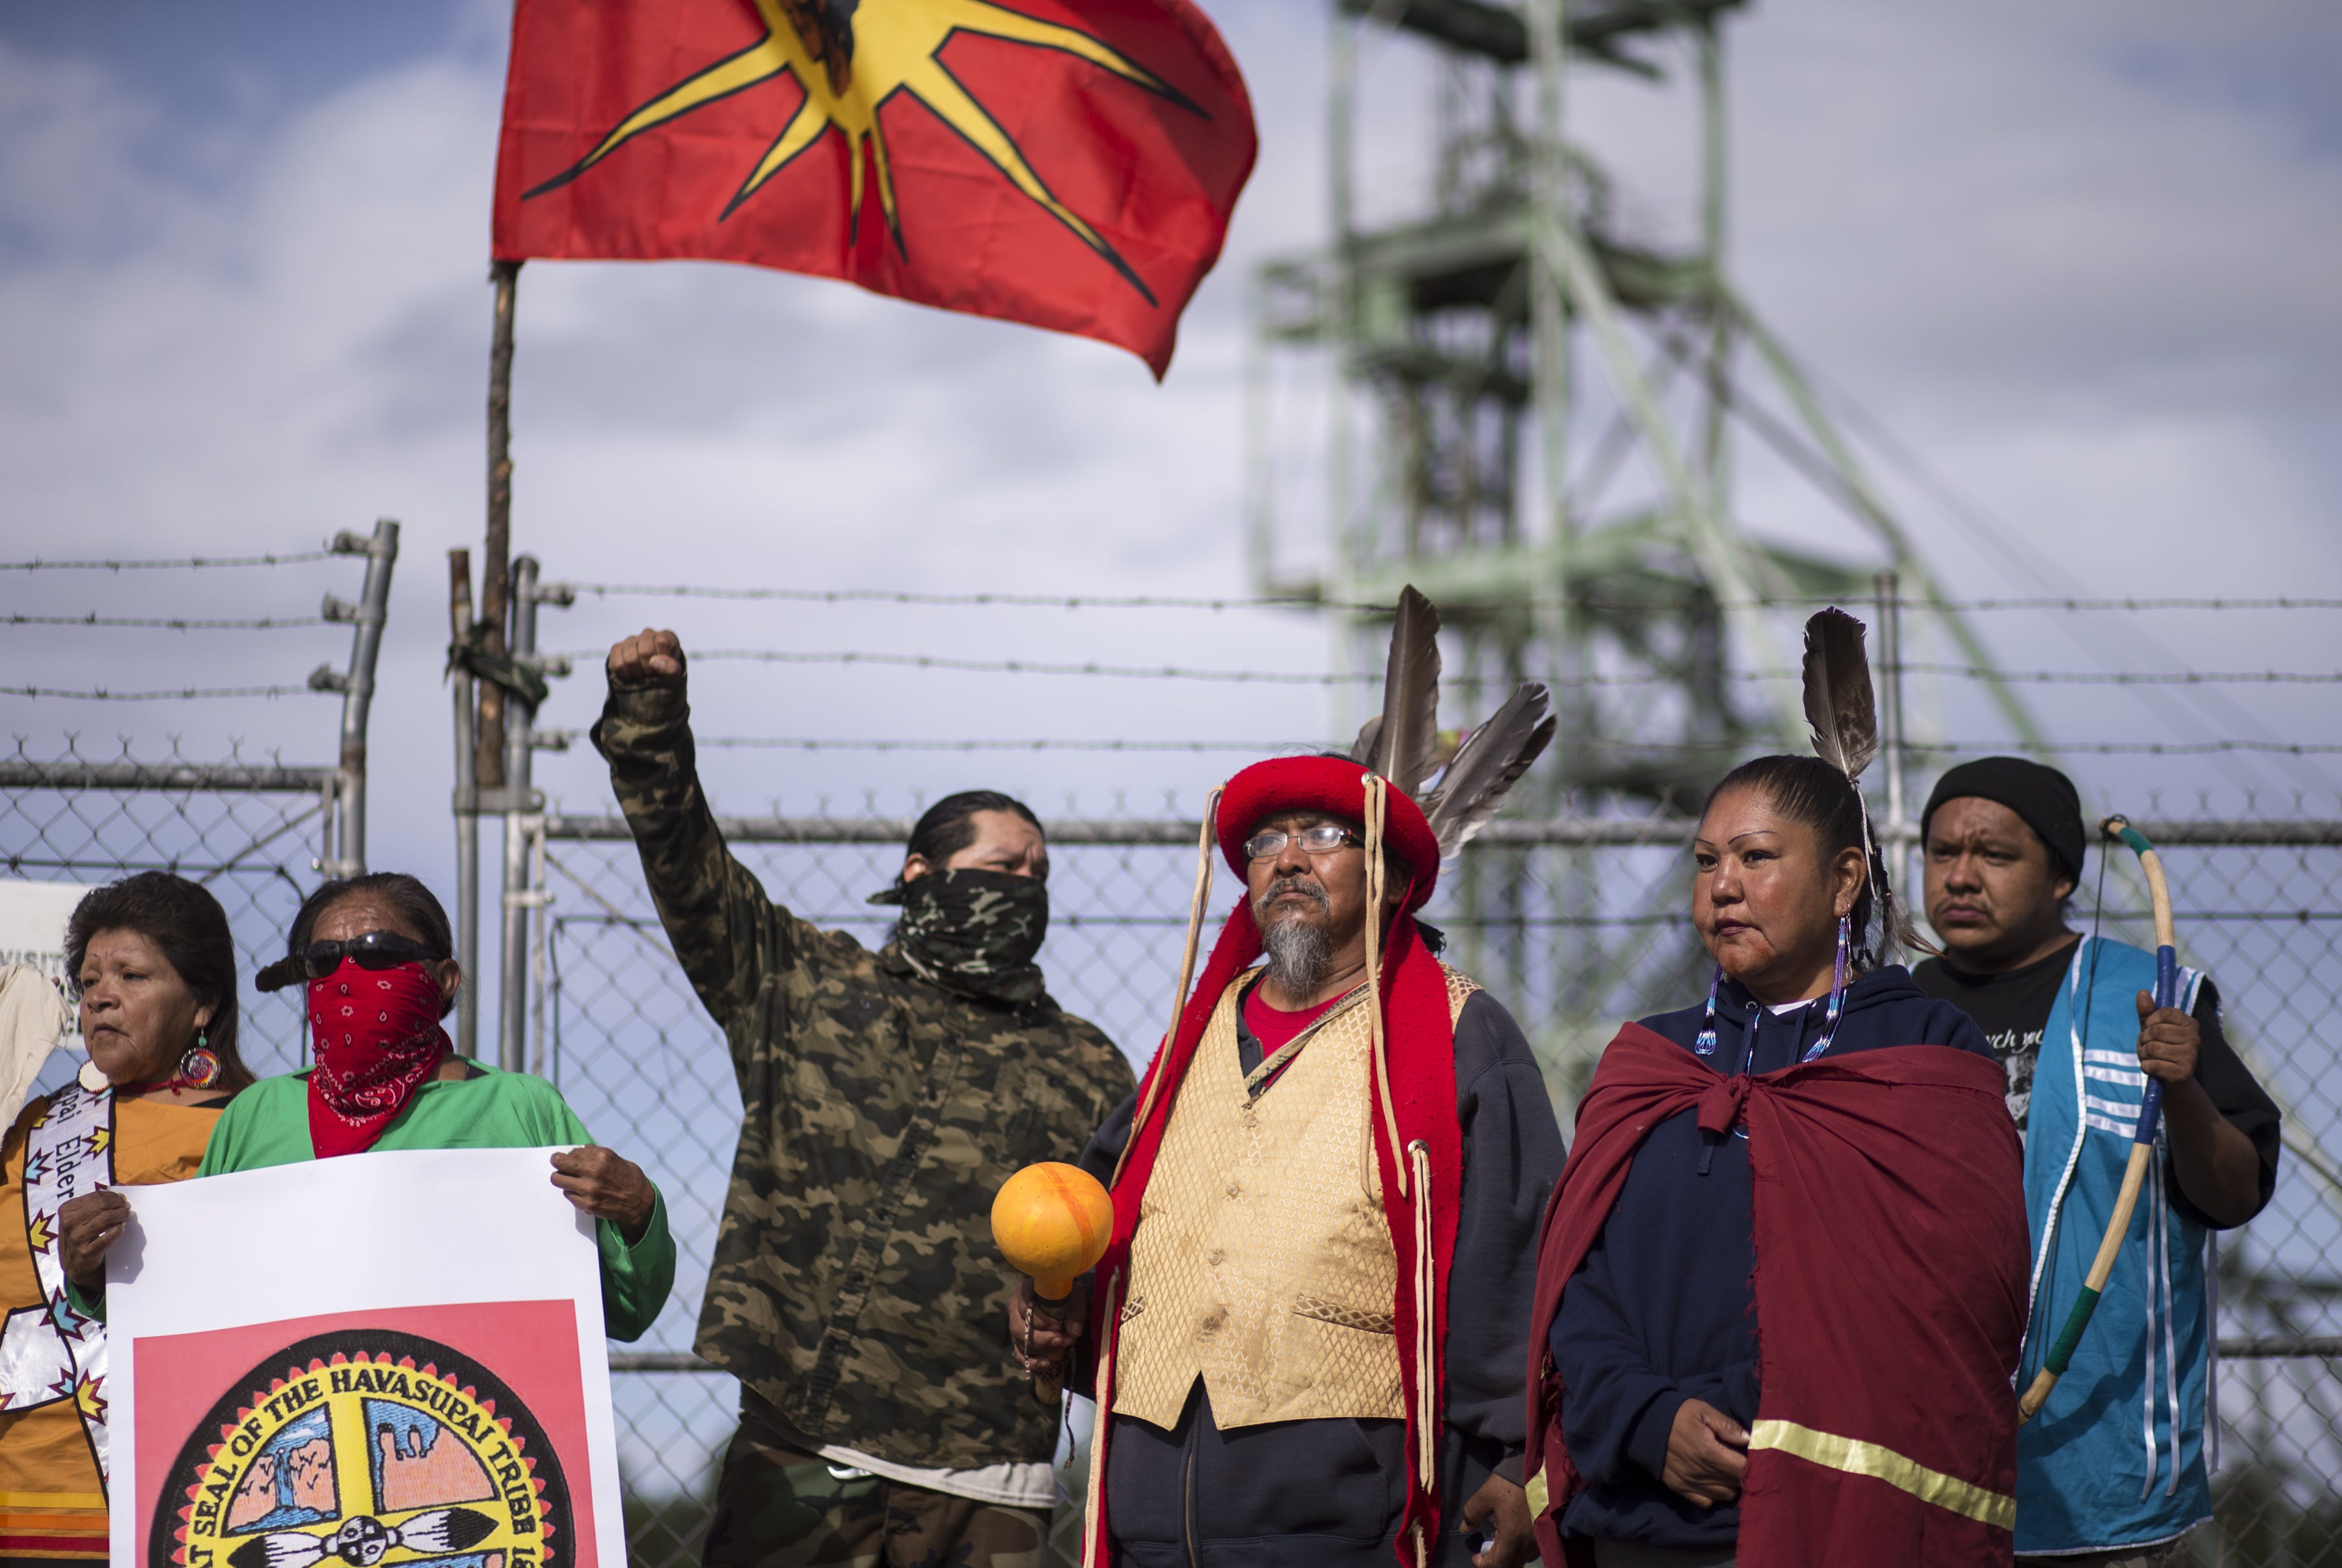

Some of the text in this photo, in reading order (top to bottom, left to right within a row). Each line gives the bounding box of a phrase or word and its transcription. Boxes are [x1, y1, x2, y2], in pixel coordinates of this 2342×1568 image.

[55, 1134, 81, 1200] Elder
[193, 1464, 238, 1537] SEAL
[232, 1416, 263, 1457] OF
[263, 1378, 323, 1422] THE
[330, 1368, 496, 1444] HAVASUPAI
[488, 1441, 536, 1534] TRIBE
